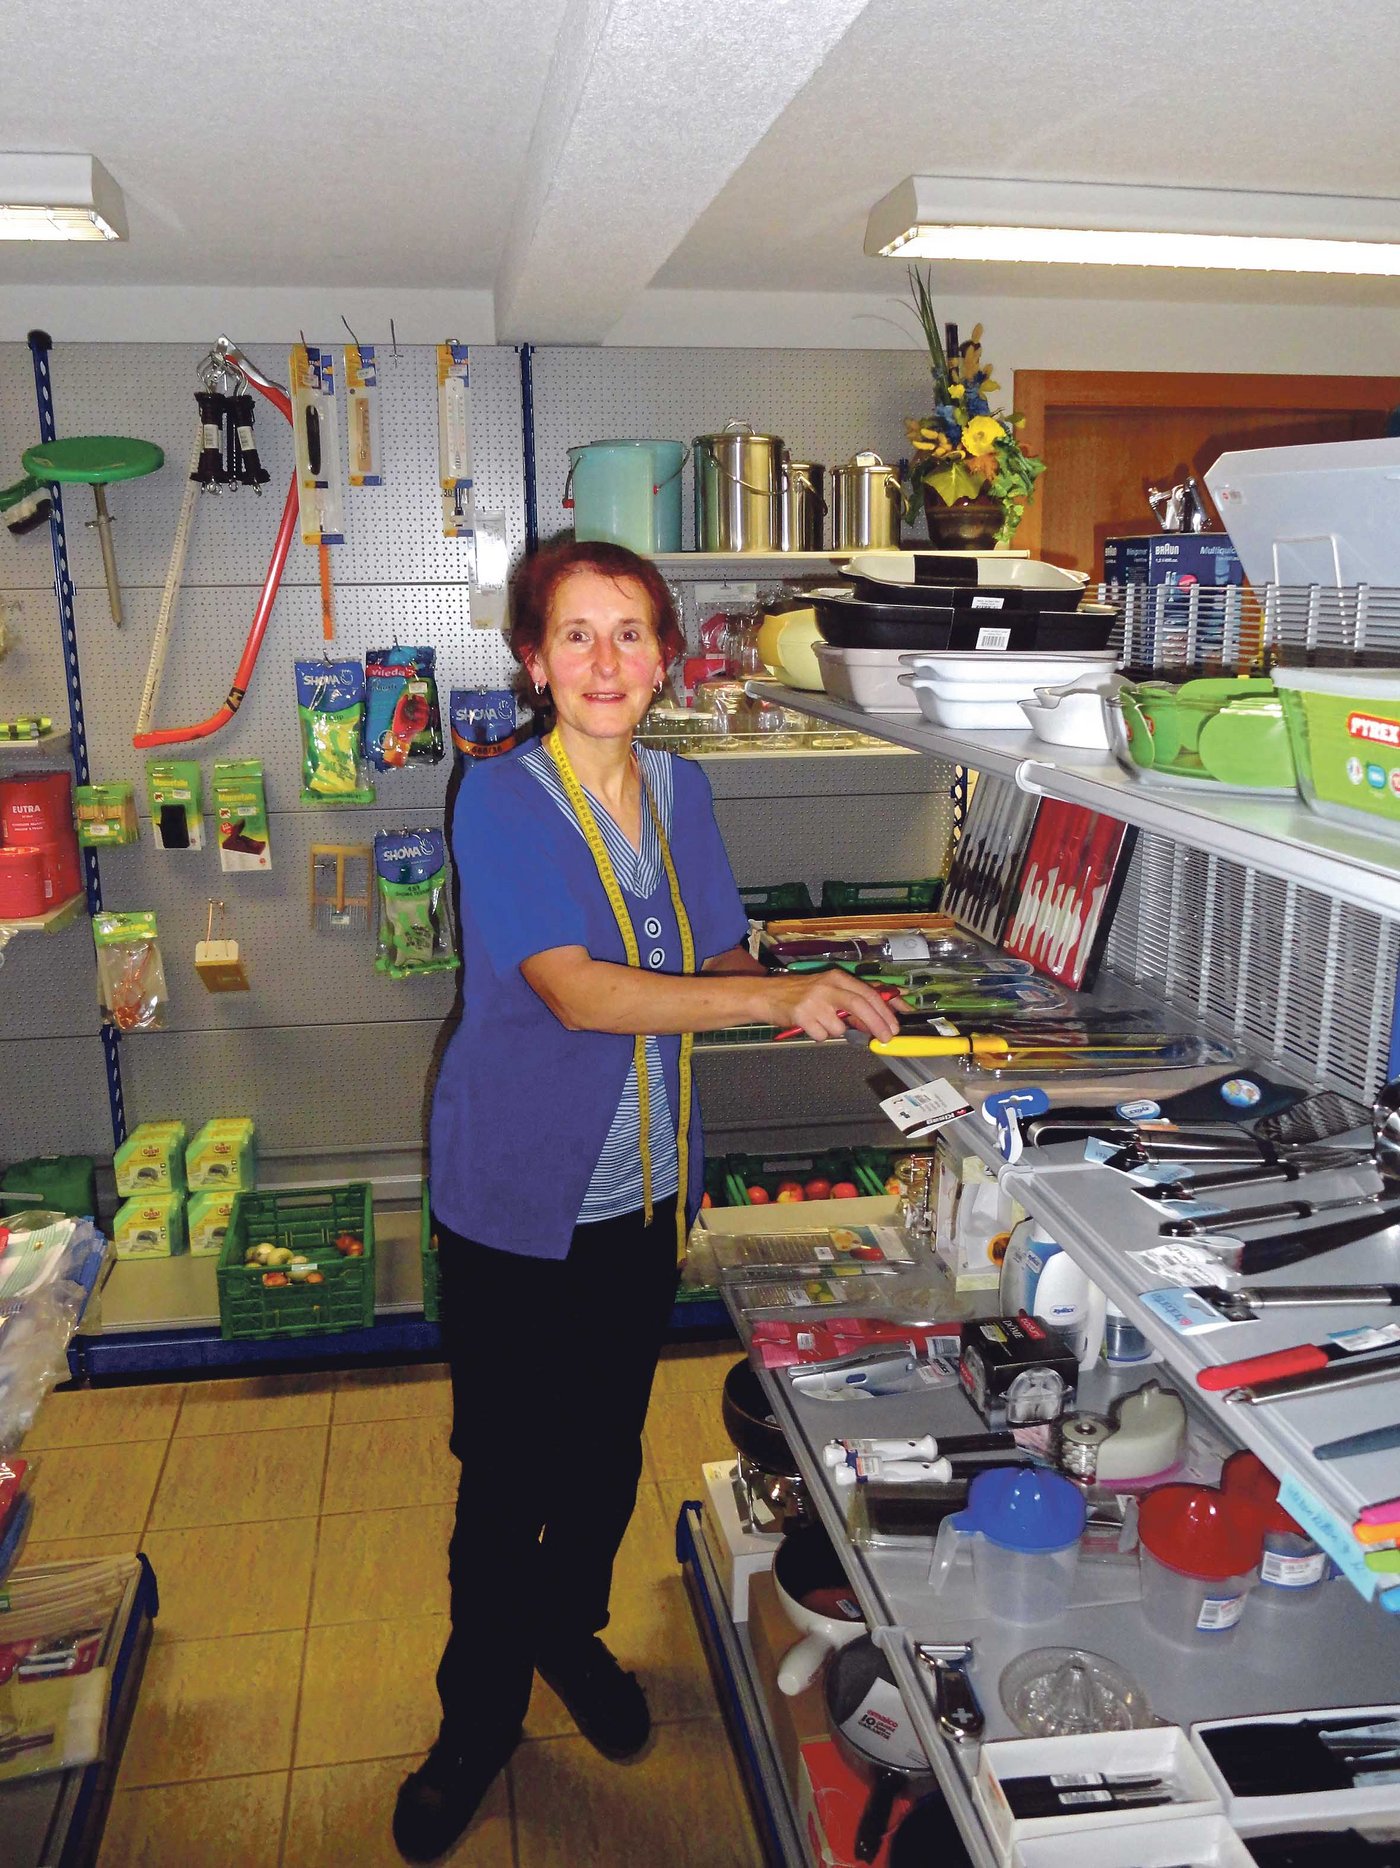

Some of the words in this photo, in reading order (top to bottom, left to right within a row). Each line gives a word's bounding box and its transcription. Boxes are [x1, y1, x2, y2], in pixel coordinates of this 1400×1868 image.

[1155, 543, 1179, 555] BRAUN
[371, 668, 405, 677] vileda
[303, 674, 340, 686] SHOWA
[1350, 717, 1400, 743] PYREX
[12, 805, 41, 814] EUTRA
[383, 847, 422, 862] SHOWA
